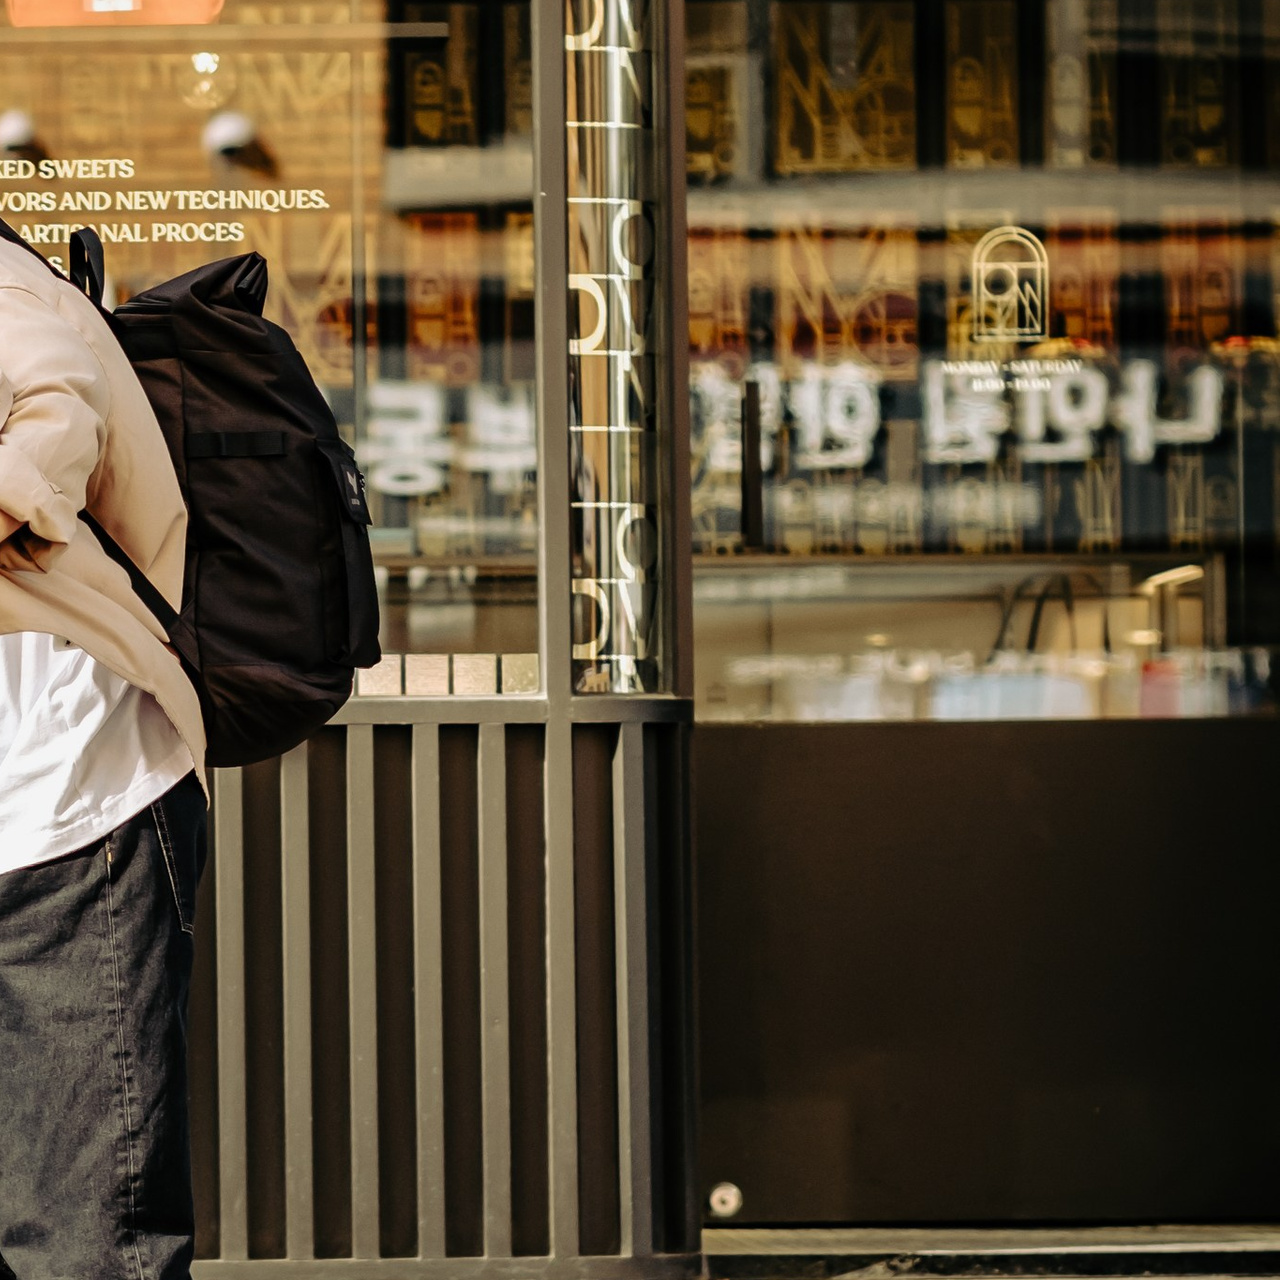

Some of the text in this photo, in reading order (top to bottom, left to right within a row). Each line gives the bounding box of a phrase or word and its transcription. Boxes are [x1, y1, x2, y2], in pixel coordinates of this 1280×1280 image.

[38, 158, 135, 180] SWEETS
[58, 191, 112, 212] AND
[115, 190, 173, 211] NEW
[173, 188, 330, 213] TECHNIQUES.
[19, 223, 149, 243] ARTINAL
[151, 222, 245, 243] PROCES
[941, 361, 999, 374] MONDAY
[1010, 360, 1083, 374] SATURDAY
